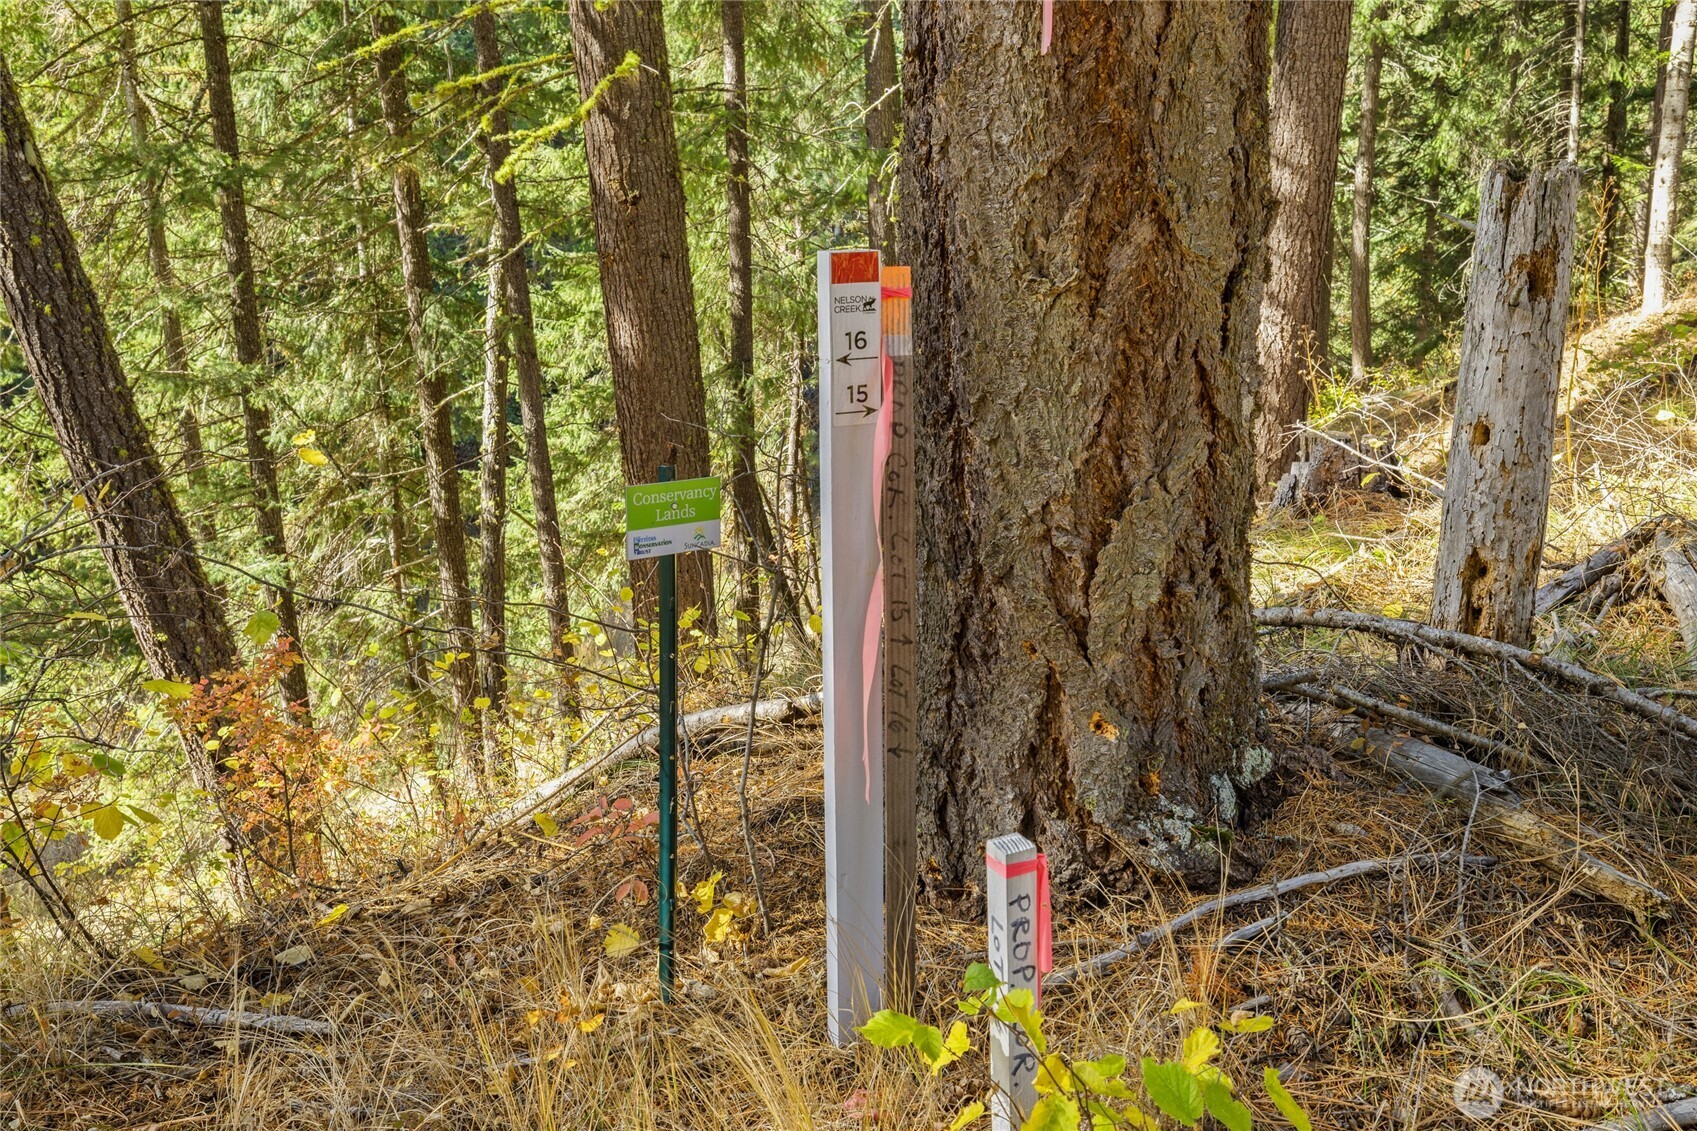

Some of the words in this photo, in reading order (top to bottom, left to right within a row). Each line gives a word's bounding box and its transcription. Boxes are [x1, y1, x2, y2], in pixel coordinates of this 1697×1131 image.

[834, 295, 868, 305] NELSON
[834, 304, 861, 314] CREEK
[844, 330, 867, 350] 16
[846, 384, 869, 404] 15
[633, 486, 717, 506] Conservancy
[656, 504, 696, 522] Lands
[890, 600, 911, 624] 15
[888, 710, 912, 734] 16
